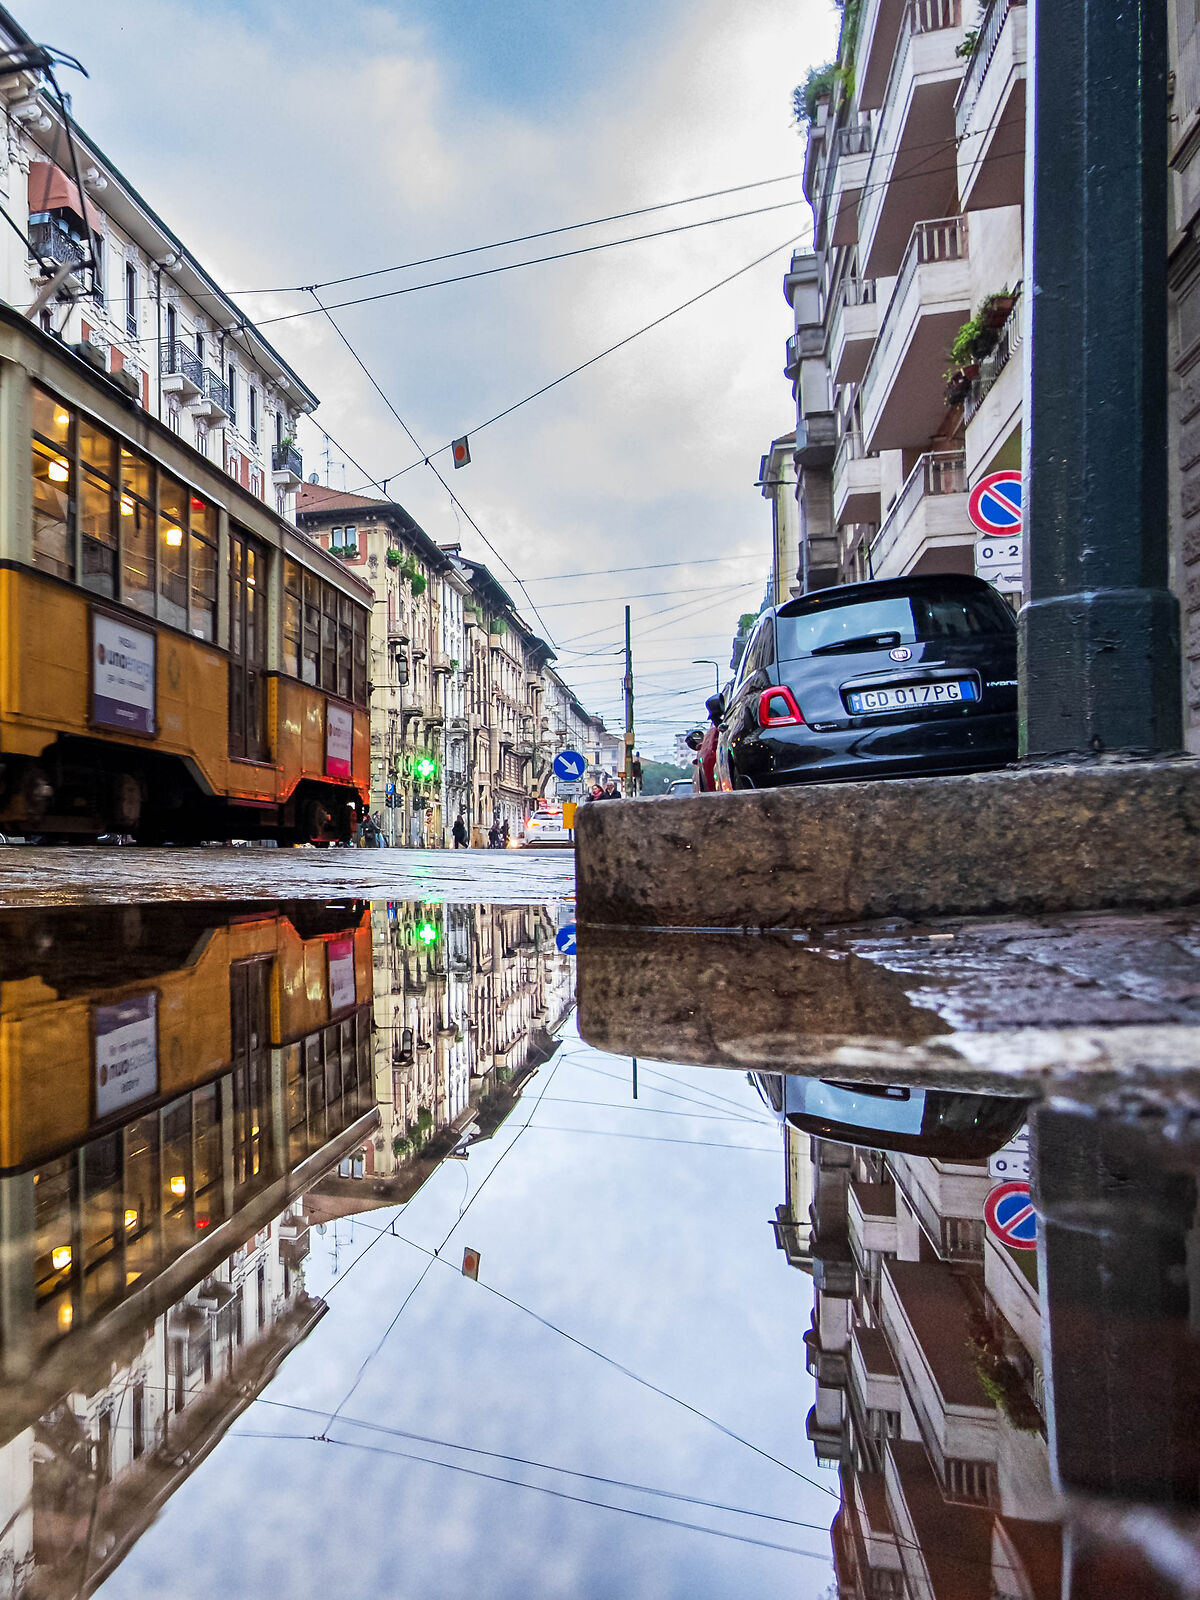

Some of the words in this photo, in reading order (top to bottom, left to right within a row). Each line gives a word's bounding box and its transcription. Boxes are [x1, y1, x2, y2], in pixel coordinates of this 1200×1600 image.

[982, 547, 993, 559] 0
[864, 691, 889, 708] GD
[894, 684, 959, 704] 017PG
